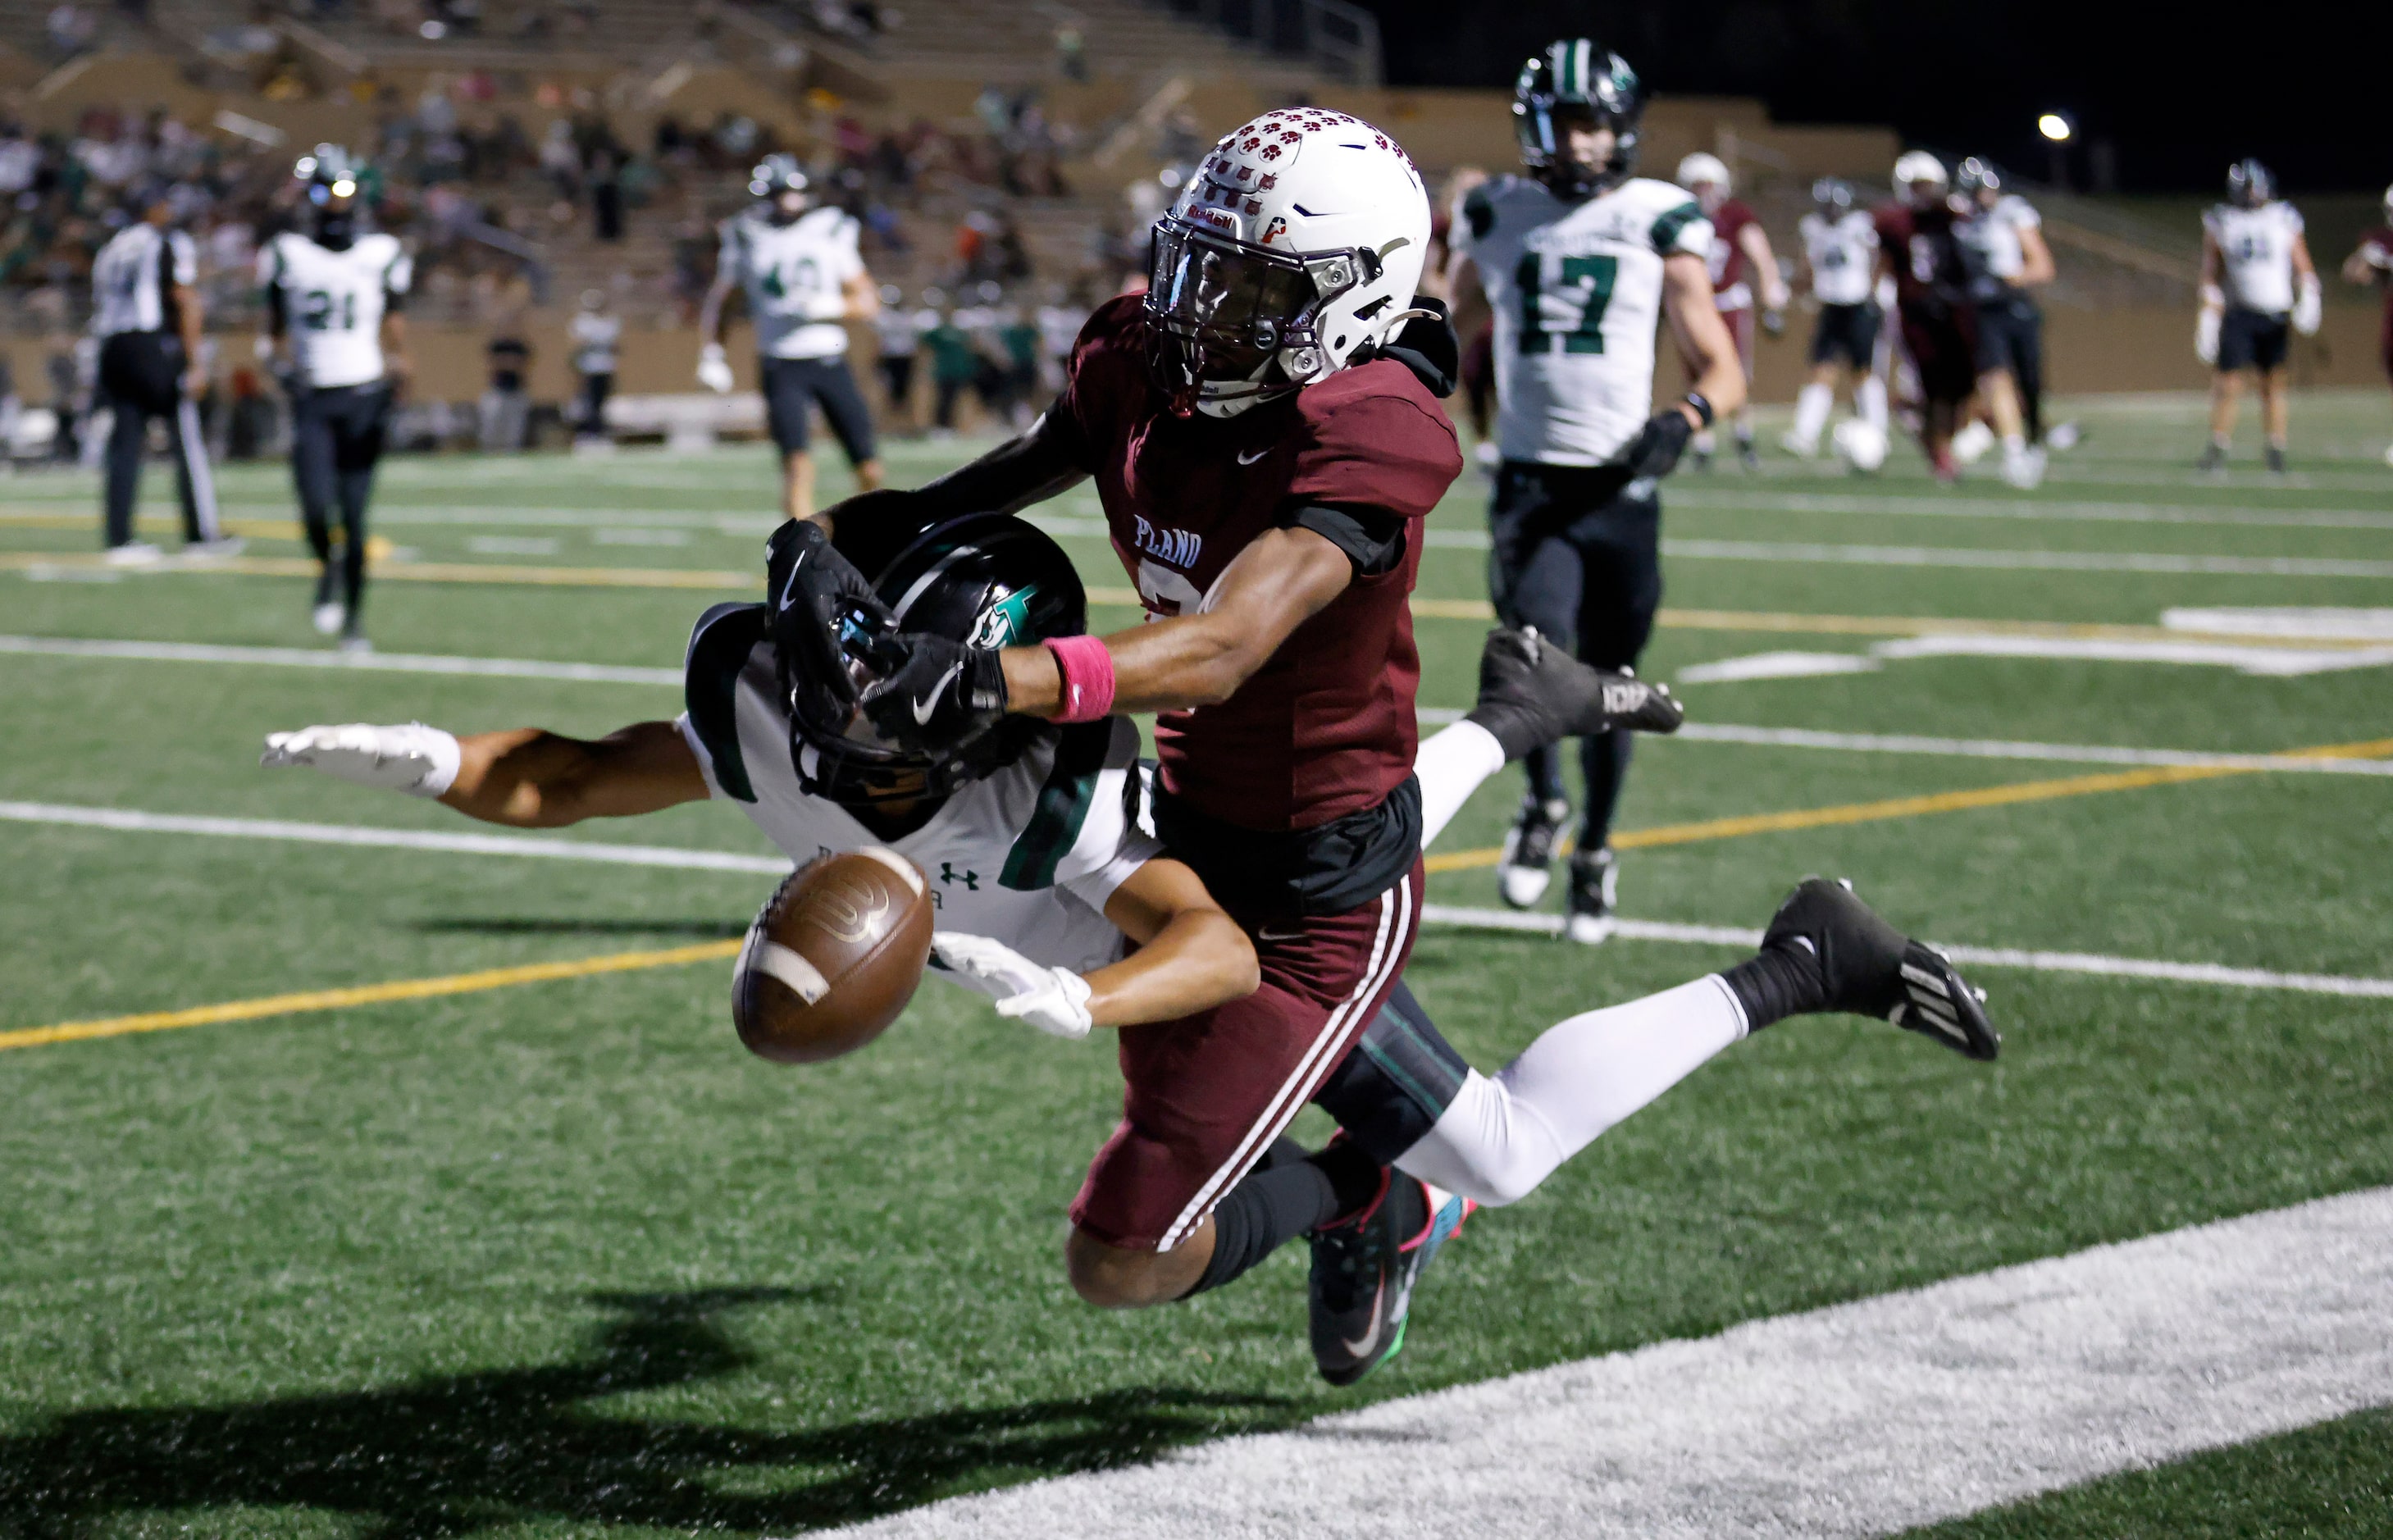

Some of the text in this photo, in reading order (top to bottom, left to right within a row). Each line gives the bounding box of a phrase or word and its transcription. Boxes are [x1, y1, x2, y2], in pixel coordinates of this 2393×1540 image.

[303, 289, 356, 330] 21
[1517, 252, 1619, 355] 17
[1133, 513, 1202, 569] PLANO
